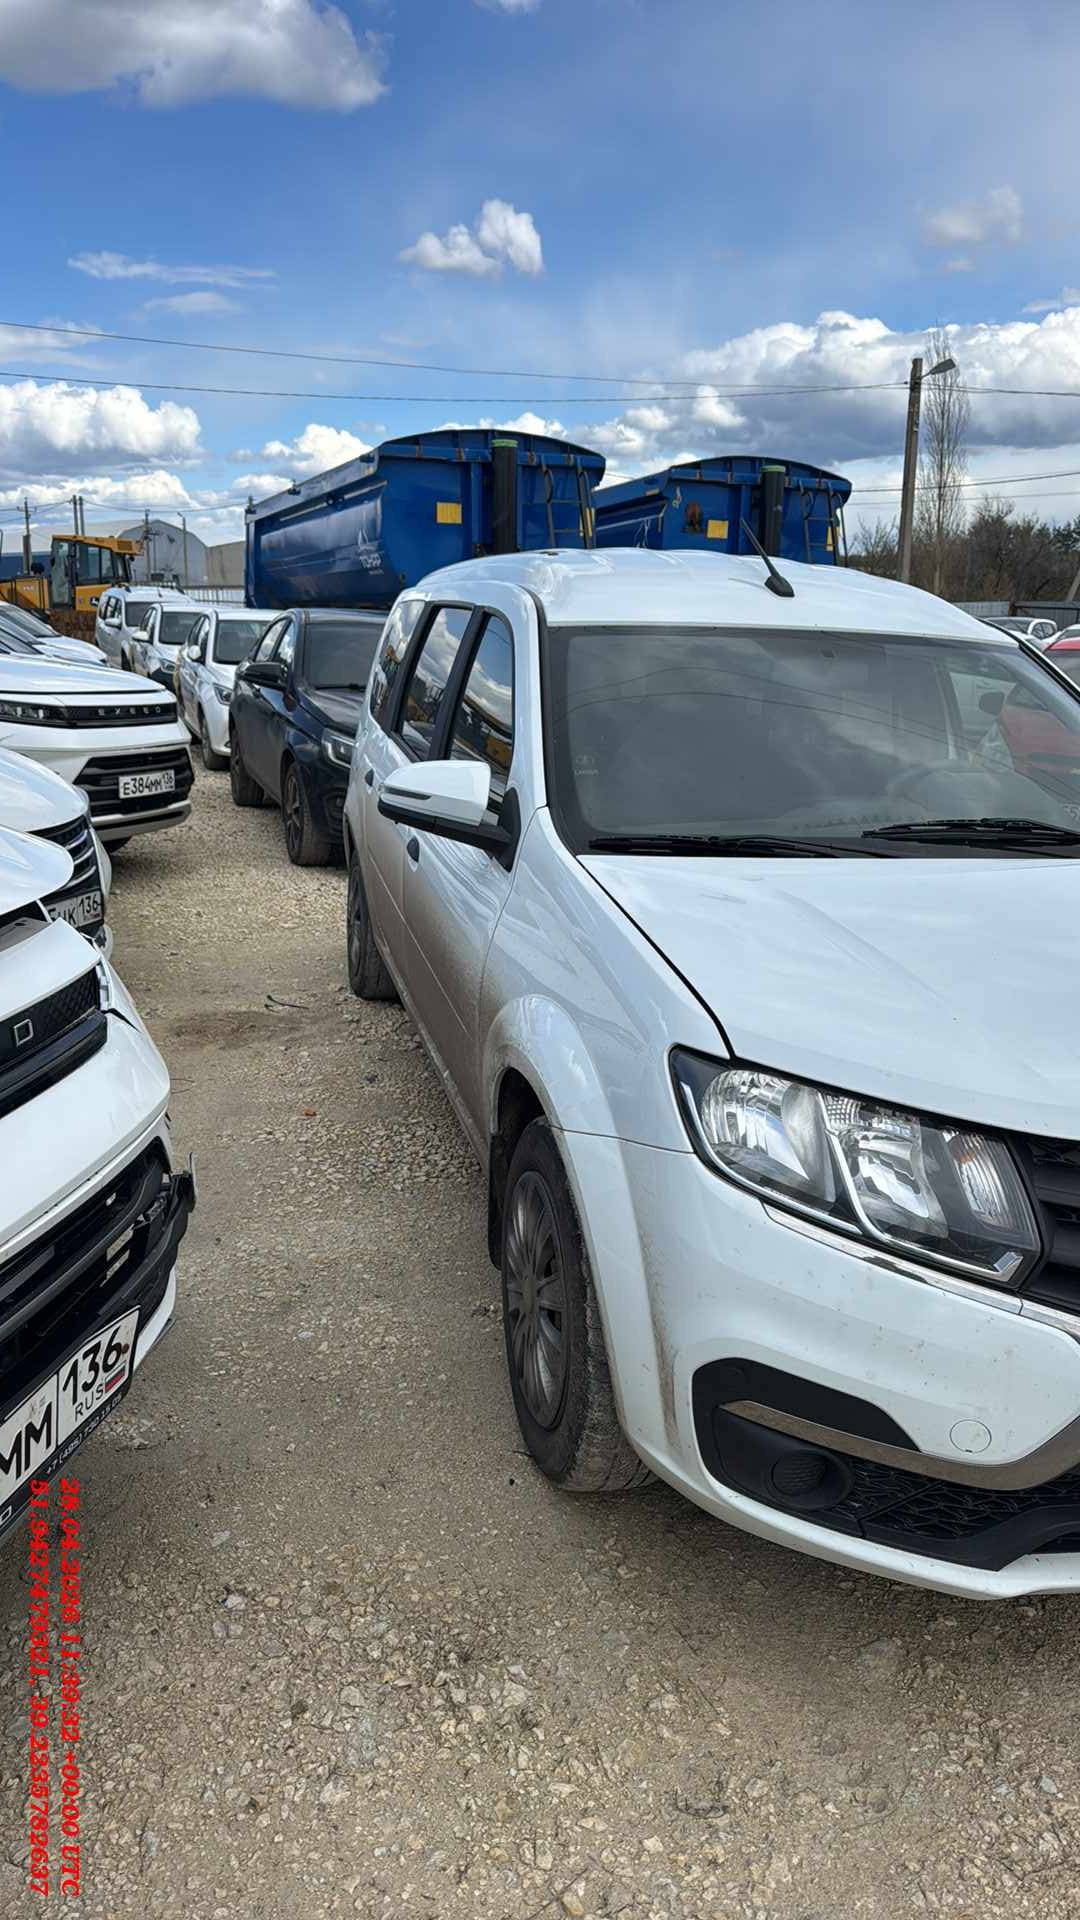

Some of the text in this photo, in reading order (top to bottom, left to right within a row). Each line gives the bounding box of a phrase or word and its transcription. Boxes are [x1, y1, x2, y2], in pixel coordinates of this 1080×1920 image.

[79, 894, 99, 914] 136
[62, 1325, 122, 1406] 136
[74, 1382, 105, 1423] RUS
